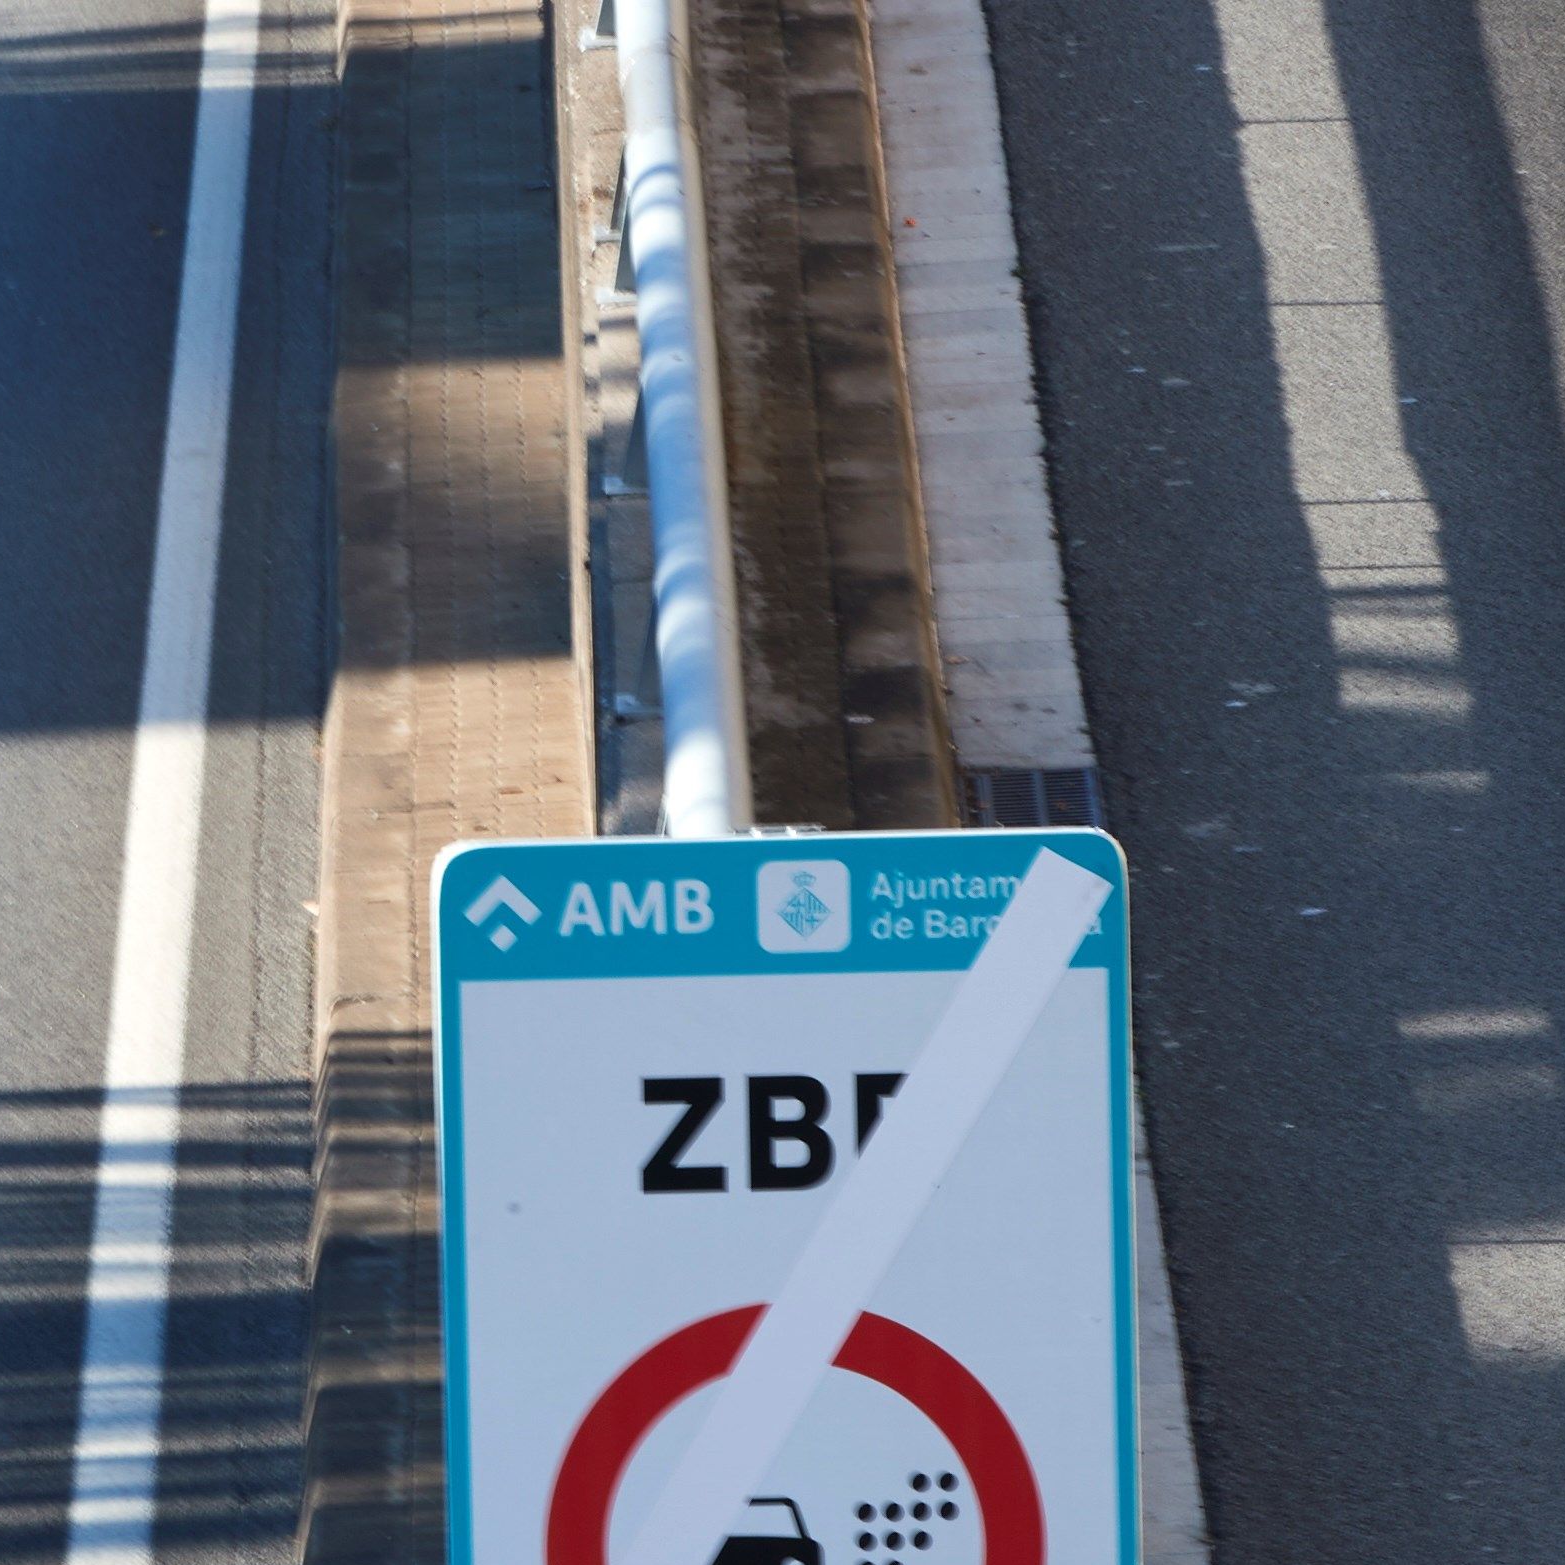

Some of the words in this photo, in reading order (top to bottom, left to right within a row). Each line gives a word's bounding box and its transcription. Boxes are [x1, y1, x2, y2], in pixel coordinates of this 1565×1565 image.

[560, 879, 715, 937] AMB
[871, 871, 1022, 908] Ajuntam
[870, 911, 915, 939] de
